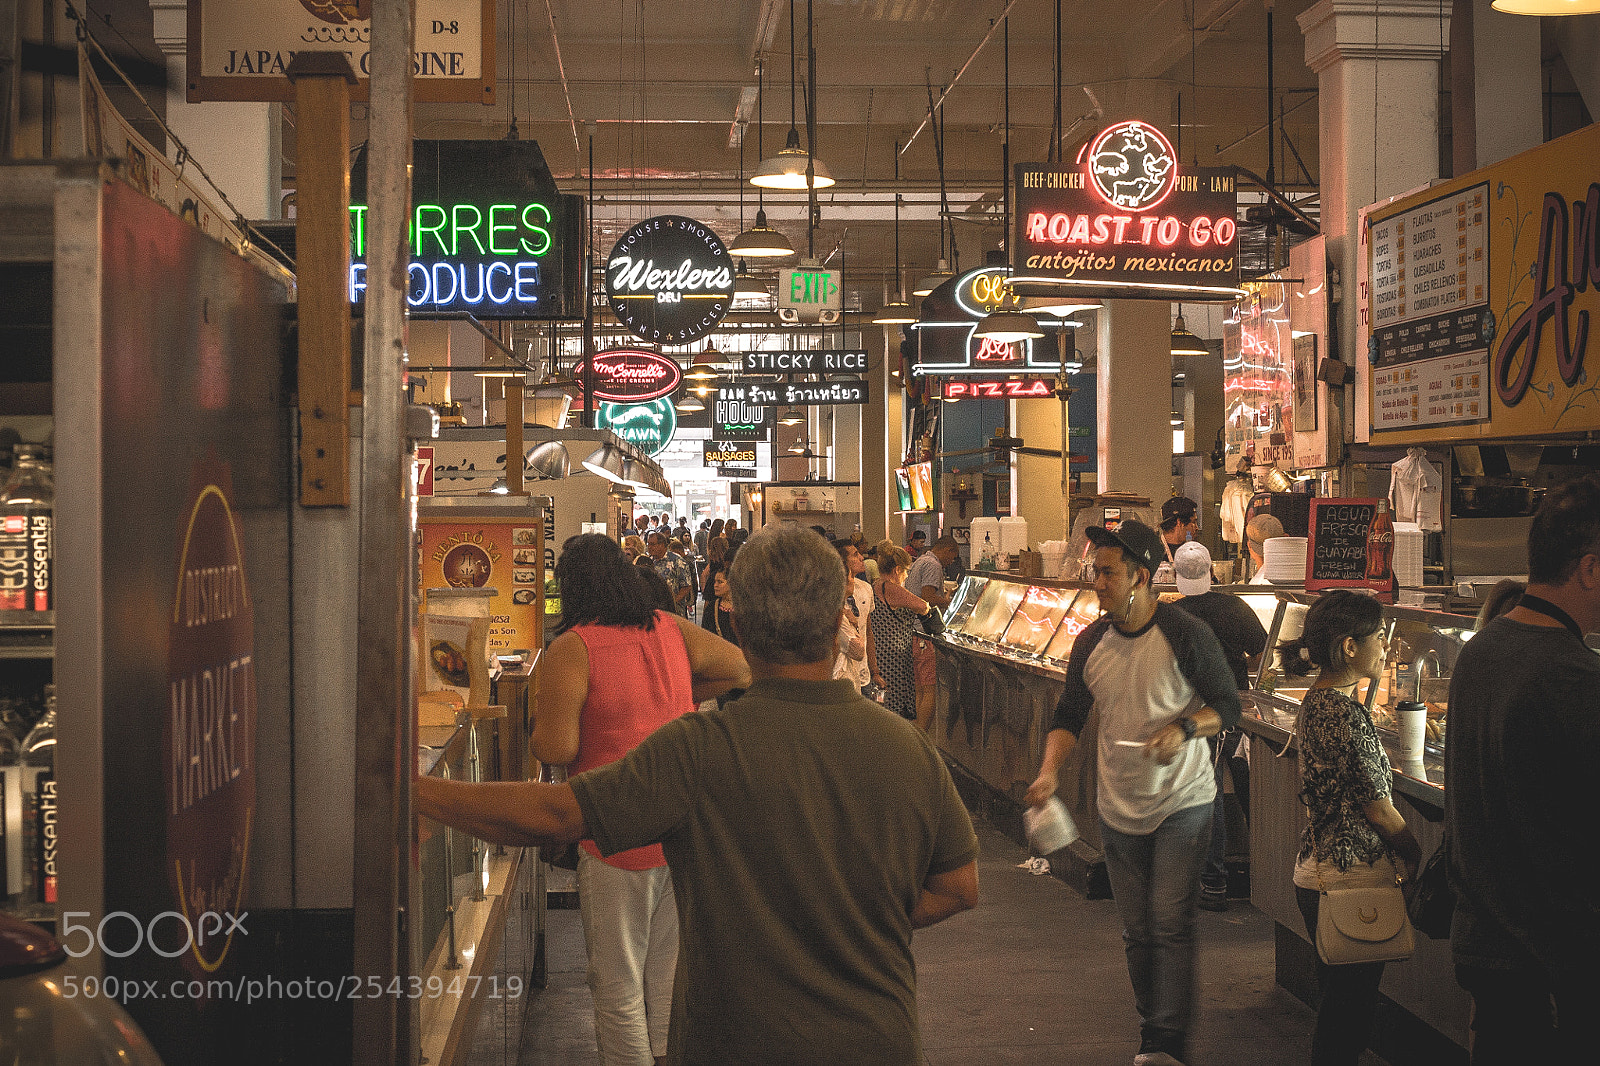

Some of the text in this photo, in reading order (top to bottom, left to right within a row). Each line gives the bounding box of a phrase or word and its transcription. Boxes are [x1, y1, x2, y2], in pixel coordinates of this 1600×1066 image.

[432, 20, 459, 34] D-8
[359, 51, 465, 76] CSINE
[1210, 177, 1234, 193] LAMB
[348, 203, 552, 257] TRRES
[620, 221, 660, 252] HOUSE
[680, 221, 722, 256] SMOKED
[1027, 212, 1236, 247] ROAST TO GO
[609, 256, 733, 291] Wexler's
[1026, 249, 1233, 278] antojitos mexicanos
[349, 261, 539, 306] PODUCE
[790, 272, 831, 304] EXIT
[657, 292, 681, 303] DELI
[617, 303, 660, 338] HAND
[680, 303, 722, 338] SLICED
[748, 353, 866, 369] STICKY RICE
[945, 380, 1050, 397] PIZZA
[706, 450, 755, 461] SAUSAGES
[1326, 506, 1370, 521] AGUA
[1321, 522, 1368, 537] FRESCA
[1331, 538, 1349, 546] DE
[31, 516, 48, 590] essentia
[1320, 561, 1356, 571] FRESH
[501, 627, 516, 636] Son
[171, 656, 251, 816] MARKET
